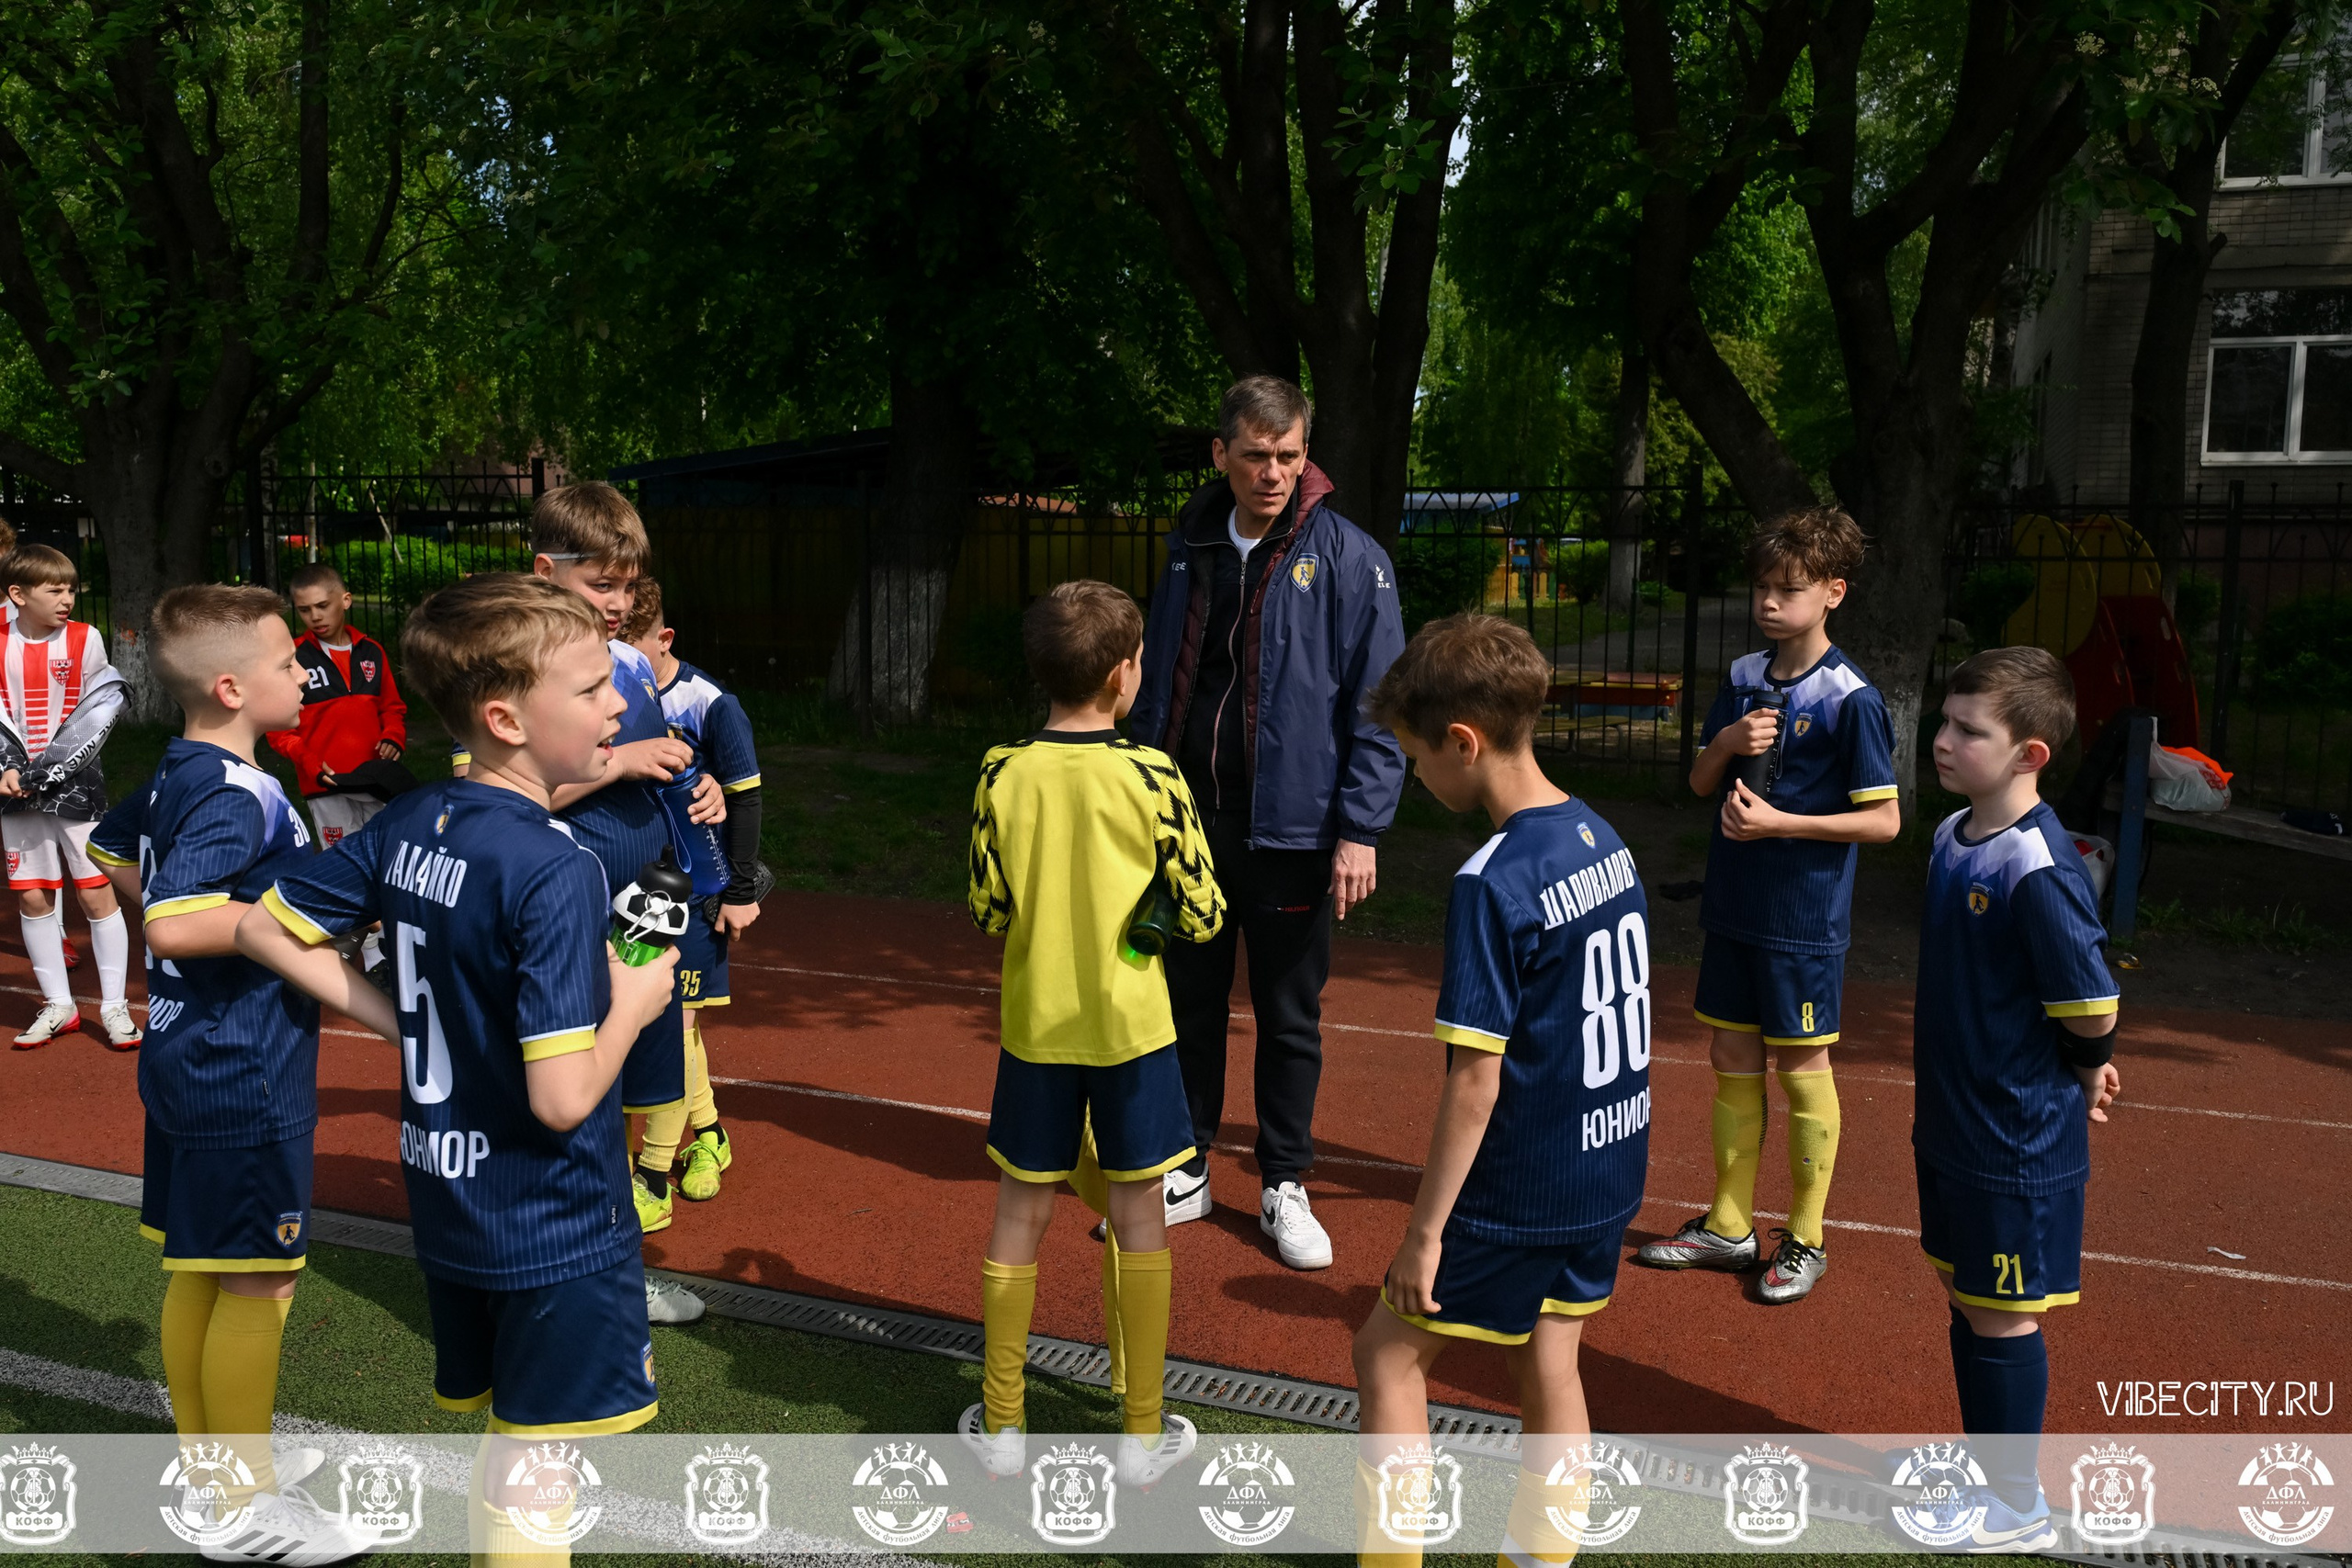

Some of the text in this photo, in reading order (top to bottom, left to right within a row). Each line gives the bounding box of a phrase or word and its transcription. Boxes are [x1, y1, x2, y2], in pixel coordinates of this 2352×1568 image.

[306, 666, 330, 689] 21
[67, 740, 96, 770] NIKE
[288, 806, 311, 848] 30
[1539, 847, 1636, 931] ШАПОВАЛОВ
[680, 969, 701, 997] 35
[1582, 912, 1650, 1089] 88
[397, 920, 453, 1104] 5
[1802, 1002, 1815, 1032] 8
[1993, 1254, 2024, 1294] 21
